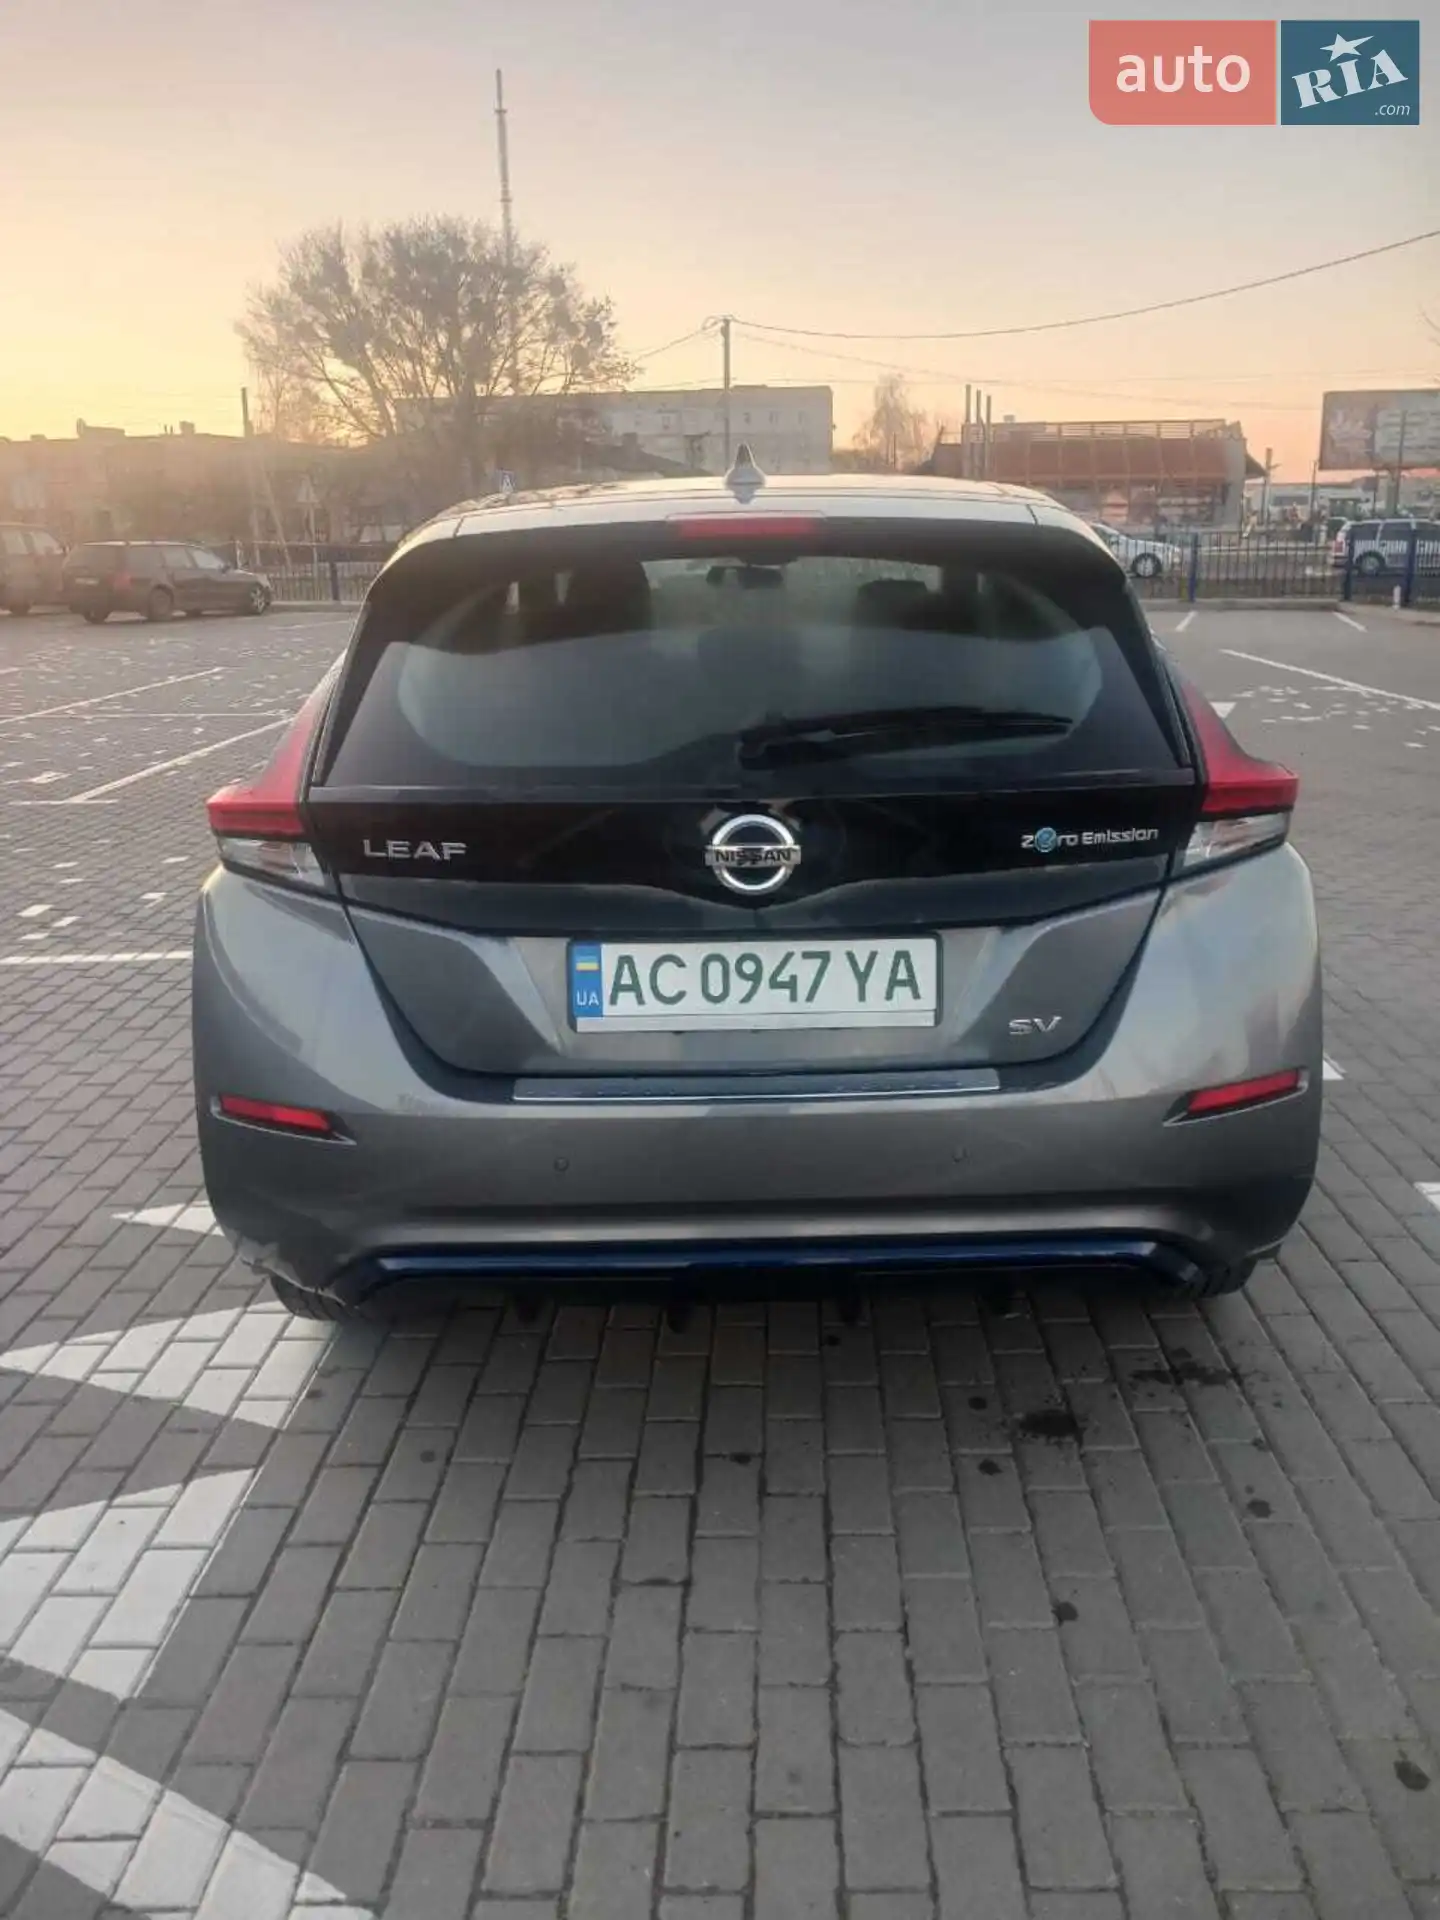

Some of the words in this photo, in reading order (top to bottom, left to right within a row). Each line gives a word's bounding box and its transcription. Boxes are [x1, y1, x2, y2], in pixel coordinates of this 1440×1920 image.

[1082, 827, 1159, 847] Emission
[362, 838, 468, 861] LEAF
[714, 848, 792, 863] NISSAN
[609, 953, 688, 1006] AC
[700, 950, 832, 1004] 0947
[845, 949, 922, 1003] YA
[576, 991, 600, 1007] UA
[1008, 1016, 1062, 1035] SV
